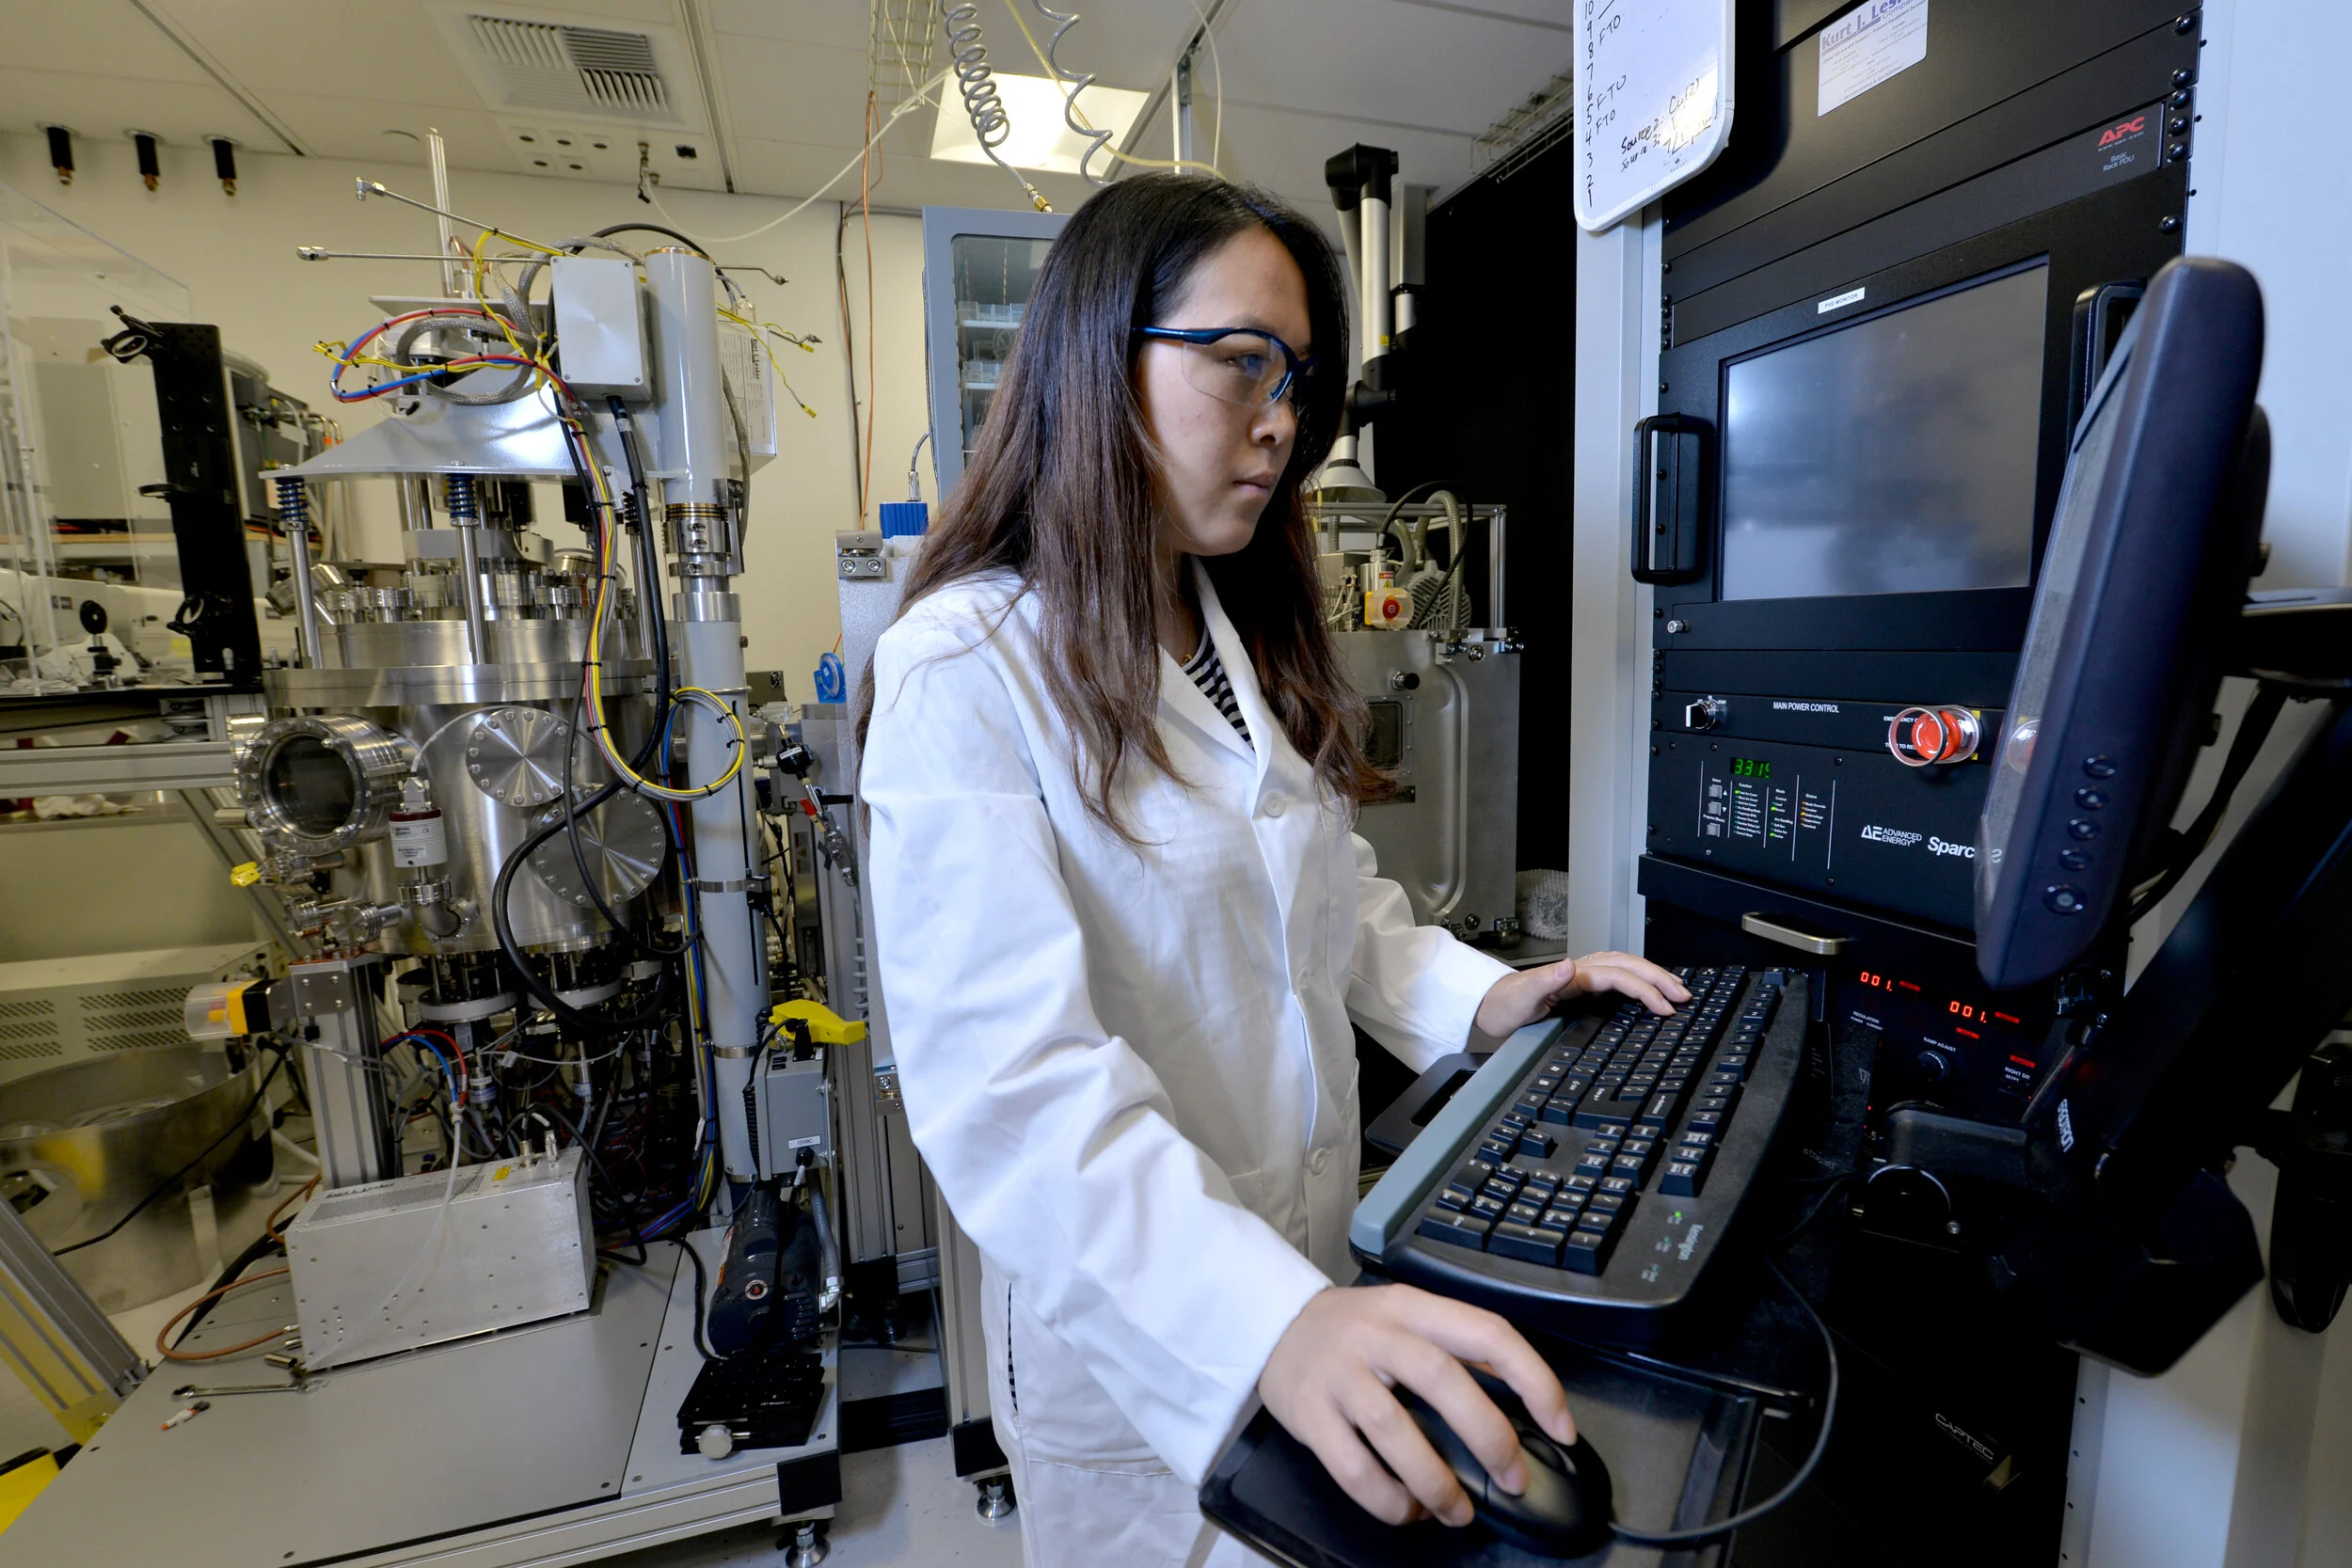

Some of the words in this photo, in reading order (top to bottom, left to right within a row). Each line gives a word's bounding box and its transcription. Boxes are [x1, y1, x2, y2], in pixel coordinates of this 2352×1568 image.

[1587, 20, 1592, 40] 9
[1599, 15, 1621, 45] FTO
[1822, 22, 1851, 50] Kurt
[1857, 14, 1865, 32] J.
[1872, 0, 1902, 20] Les
[1588, 41, 1594, 59] 8
[1587, 62, 1593, 81] 7
[1588, 84, 1593, 102] 6
[1587, 103, 1594, 125] 5
[1596, 109, 1616, 135] FTO
[1585, 129, 1592, 146] 4
[2098, 116, 2145, 146] APC
[1587, 152, 1593, 168] 3
[1586, 174, 1594, 188] 2
[1588, 188, 1592, 208] 1
[1836, 293, 1858, 304] MONITOR
[1773, 701, 1787, 710] MAIN
[1788, 702, 1810, 711] POWER
[1810, 703, 1840, 713] CONTROL
[1882, 828, 1922, 841] ADVANCED
[1853, 1010, 1880, 1024] REGULATION
[1923, 1037, 1937, 1045] RAMP
[1937, 1041, 1957, 1053] ADJUST
[2004, 1066, 2020, 1078] RIGHT
